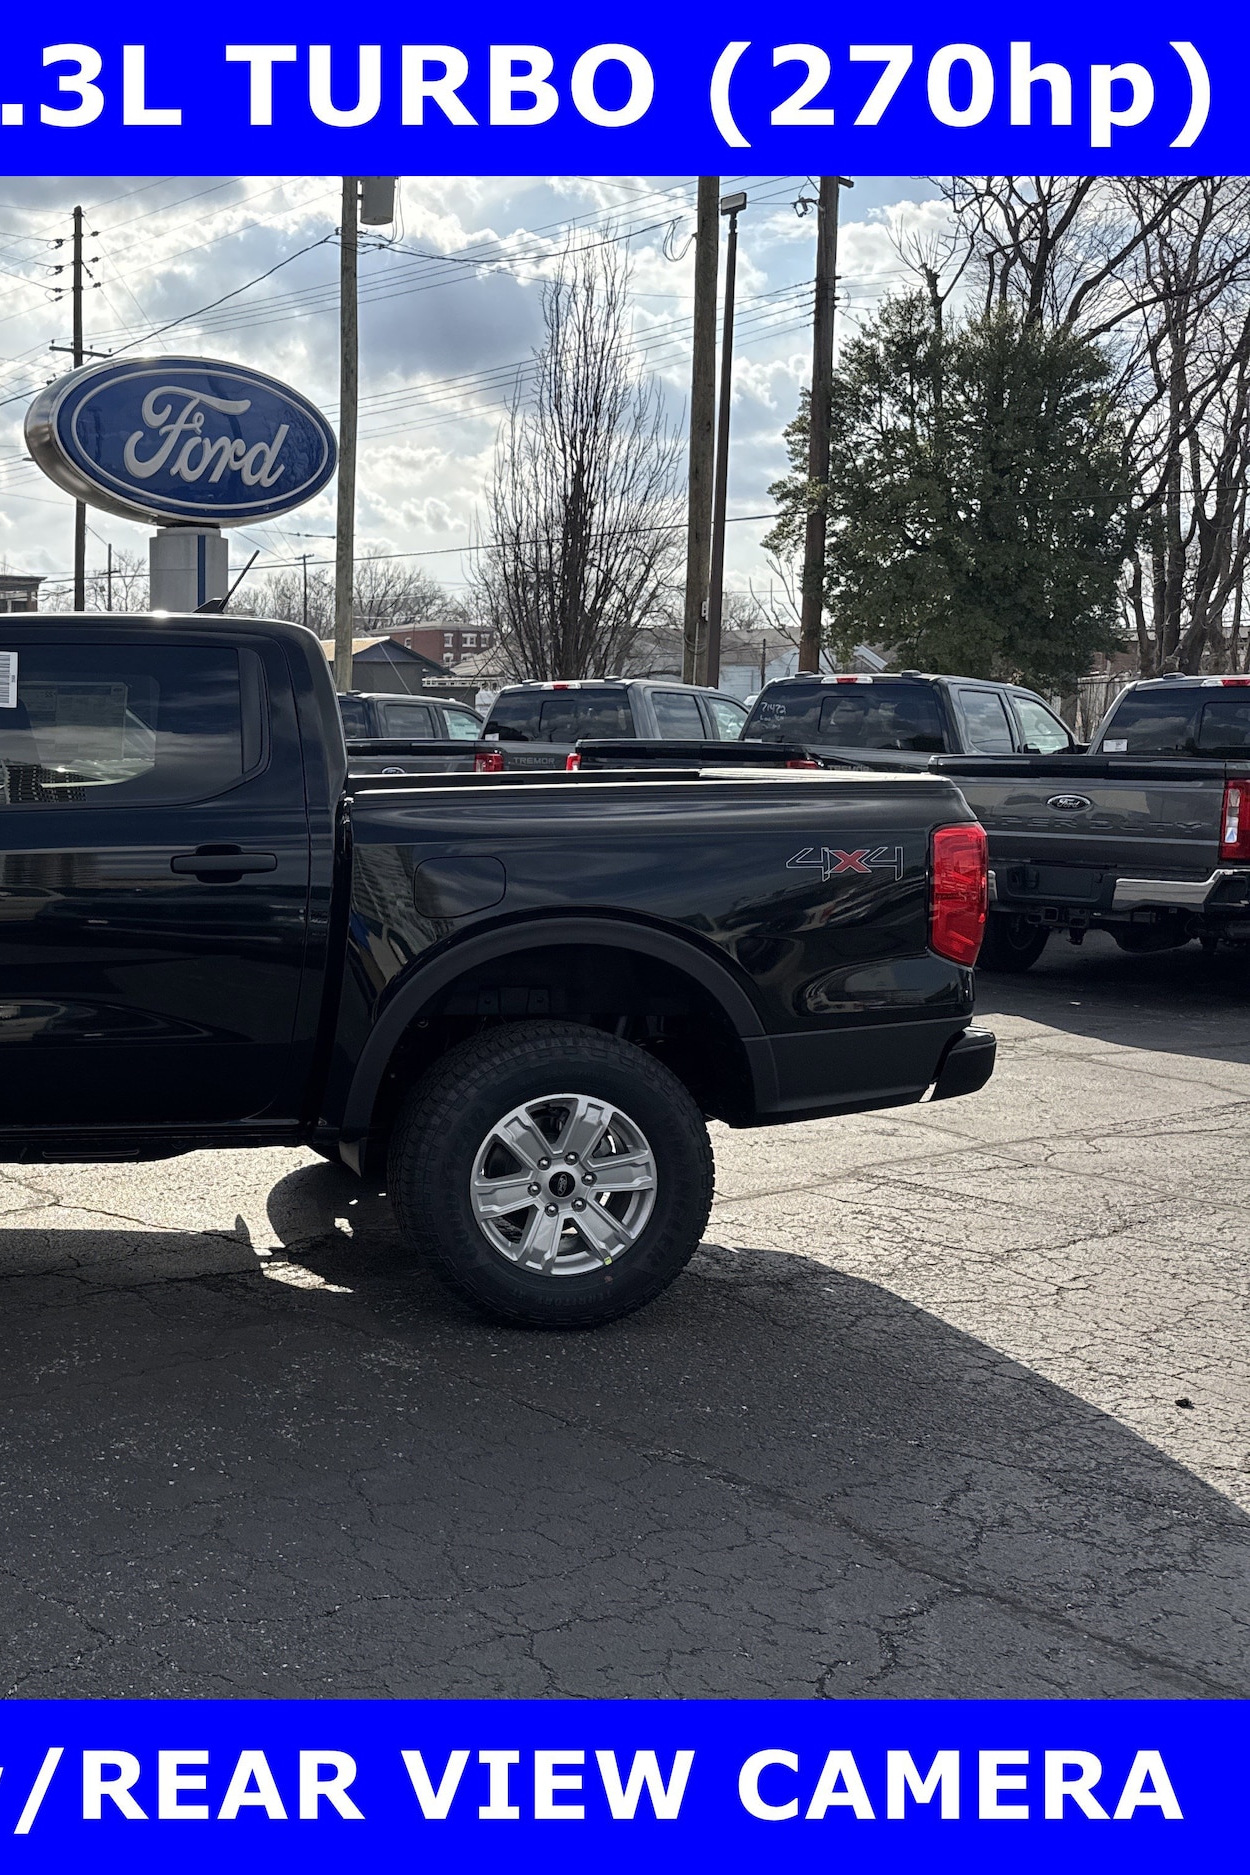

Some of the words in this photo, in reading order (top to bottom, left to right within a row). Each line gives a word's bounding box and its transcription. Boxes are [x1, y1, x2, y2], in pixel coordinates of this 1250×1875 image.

[123, 385, 290, 488] Ford
[513, 756, 556, 765] TREMOR
[1056, 797, 1081, 809] Ford
